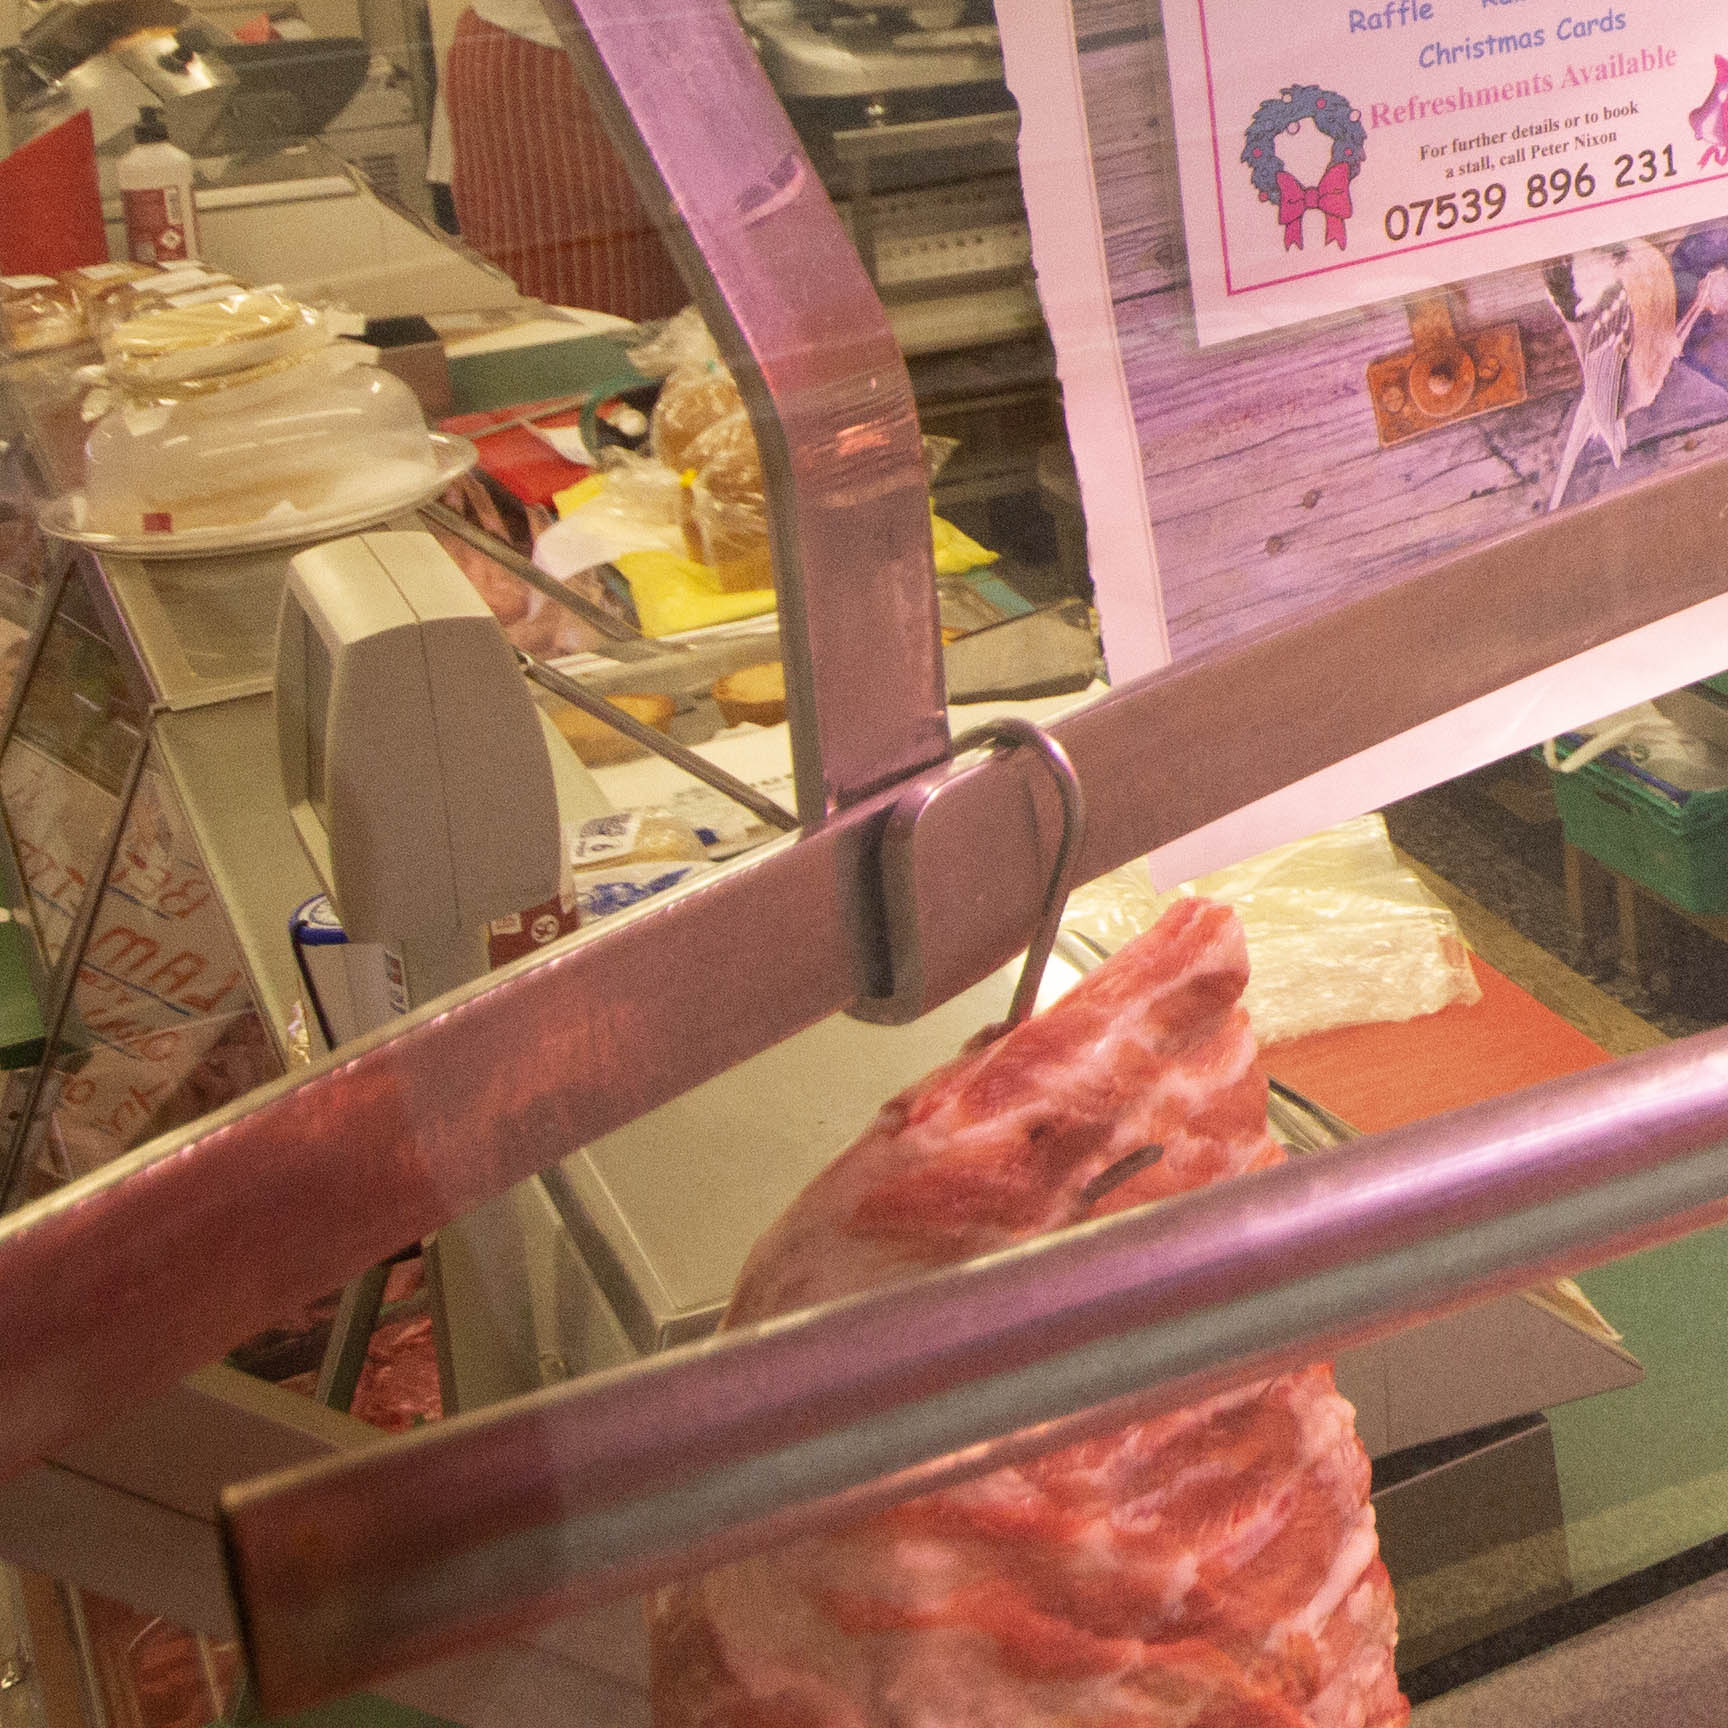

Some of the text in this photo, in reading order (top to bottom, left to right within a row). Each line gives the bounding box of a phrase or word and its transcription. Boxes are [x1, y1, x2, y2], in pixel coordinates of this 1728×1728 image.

[1418, 8, 1628, 70] Christmas Cards
[1369, 44, 1680, 130] Refreshments Available
[1418, 99, 1640, 161] For further details or to book
[1444, 128, 1618, 180] a stall, call Peter Nixon
[1383, 144, 1680, 242] 07539 896 231
